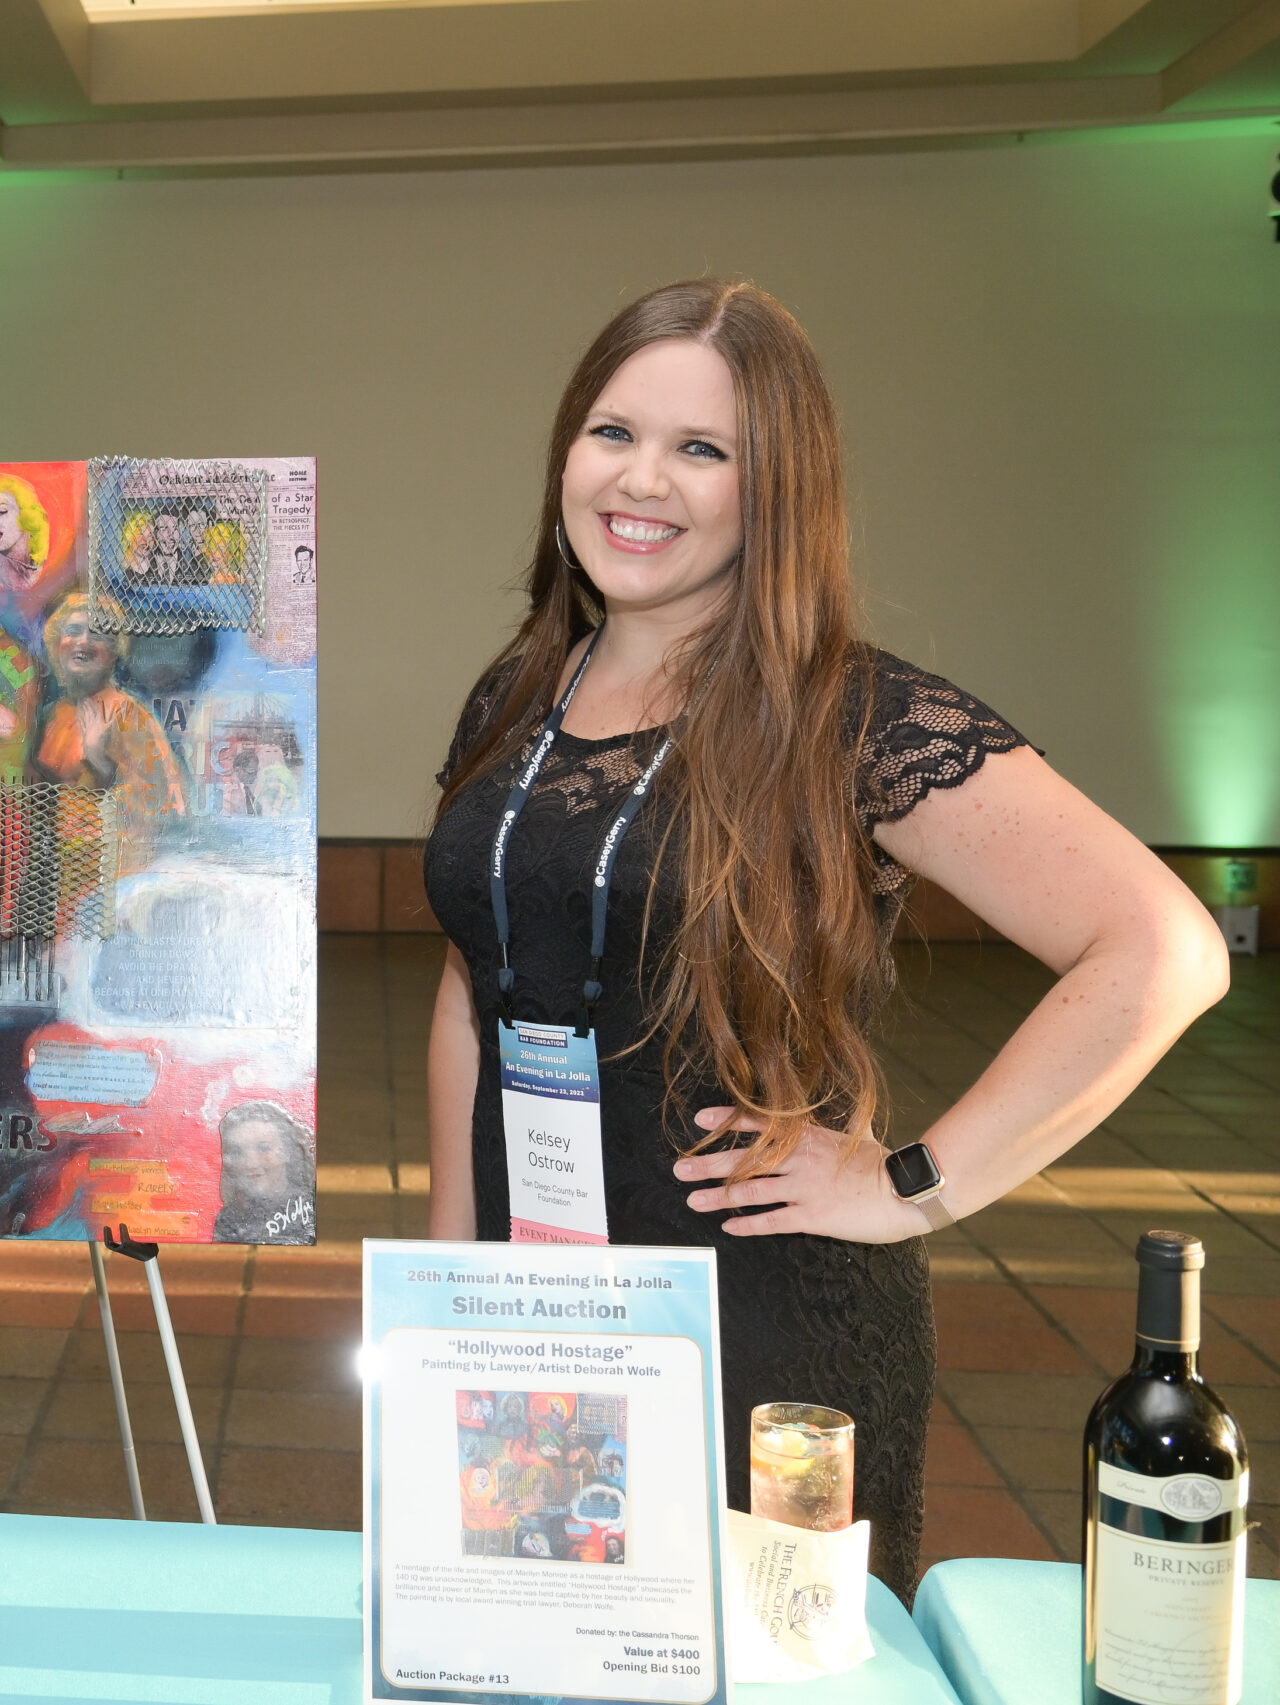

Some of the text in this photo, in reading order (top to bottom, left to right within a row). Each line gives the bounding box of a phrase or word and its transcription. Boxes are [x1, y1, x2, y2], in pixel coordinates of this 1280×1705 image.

[271, 494, 282, 503] of
[295, 493, 314, 502] Star
[272, 504, 312, 515] Tragedy
[519, 739, 551, 790] CaseyGerry
[493, 819, 513, 879] CaseyGerry
[596, 816, 626, 876] CaseyGerry
[530, 1038, 565, 1047] FOUNDATION
[520, 1050, 567, 1064] 26th Annual
[506, 1061, 590, 1081] An Evening in La Jolla
[532, 1084, 558, 1093] September
[528, 1129, 571, 1153] Kelsey
[528, 1151, 574, 1173] Ostrow
[521, 1178, 588, 1198] San Diego County Bar
[538, 1193, 571, 1206] Foundation
[520, 1226, 547, 1242] EVENT
[408, 1270, 672, 1289] 26th Annual An Evening in La Jolla
[452, 1296, 626, 1319] Silent Auction
[422, 1359, 661, 1377] Painting by Lawyer/Artist Deborah Wolfe
[773, 1543, 797, 1614] THE FRENCH
[576, 1627, 605, 1636] Donated
[632, 1630, 669, 1639] Cassandra
[671, 1632, 699, 1640] Thorson
[623, 1646, 700, 1660] Value at $400
[396, 1669, 509, 1684] Auction Package #13
[603, 1661, 700, 1675] Opening Bid $100
